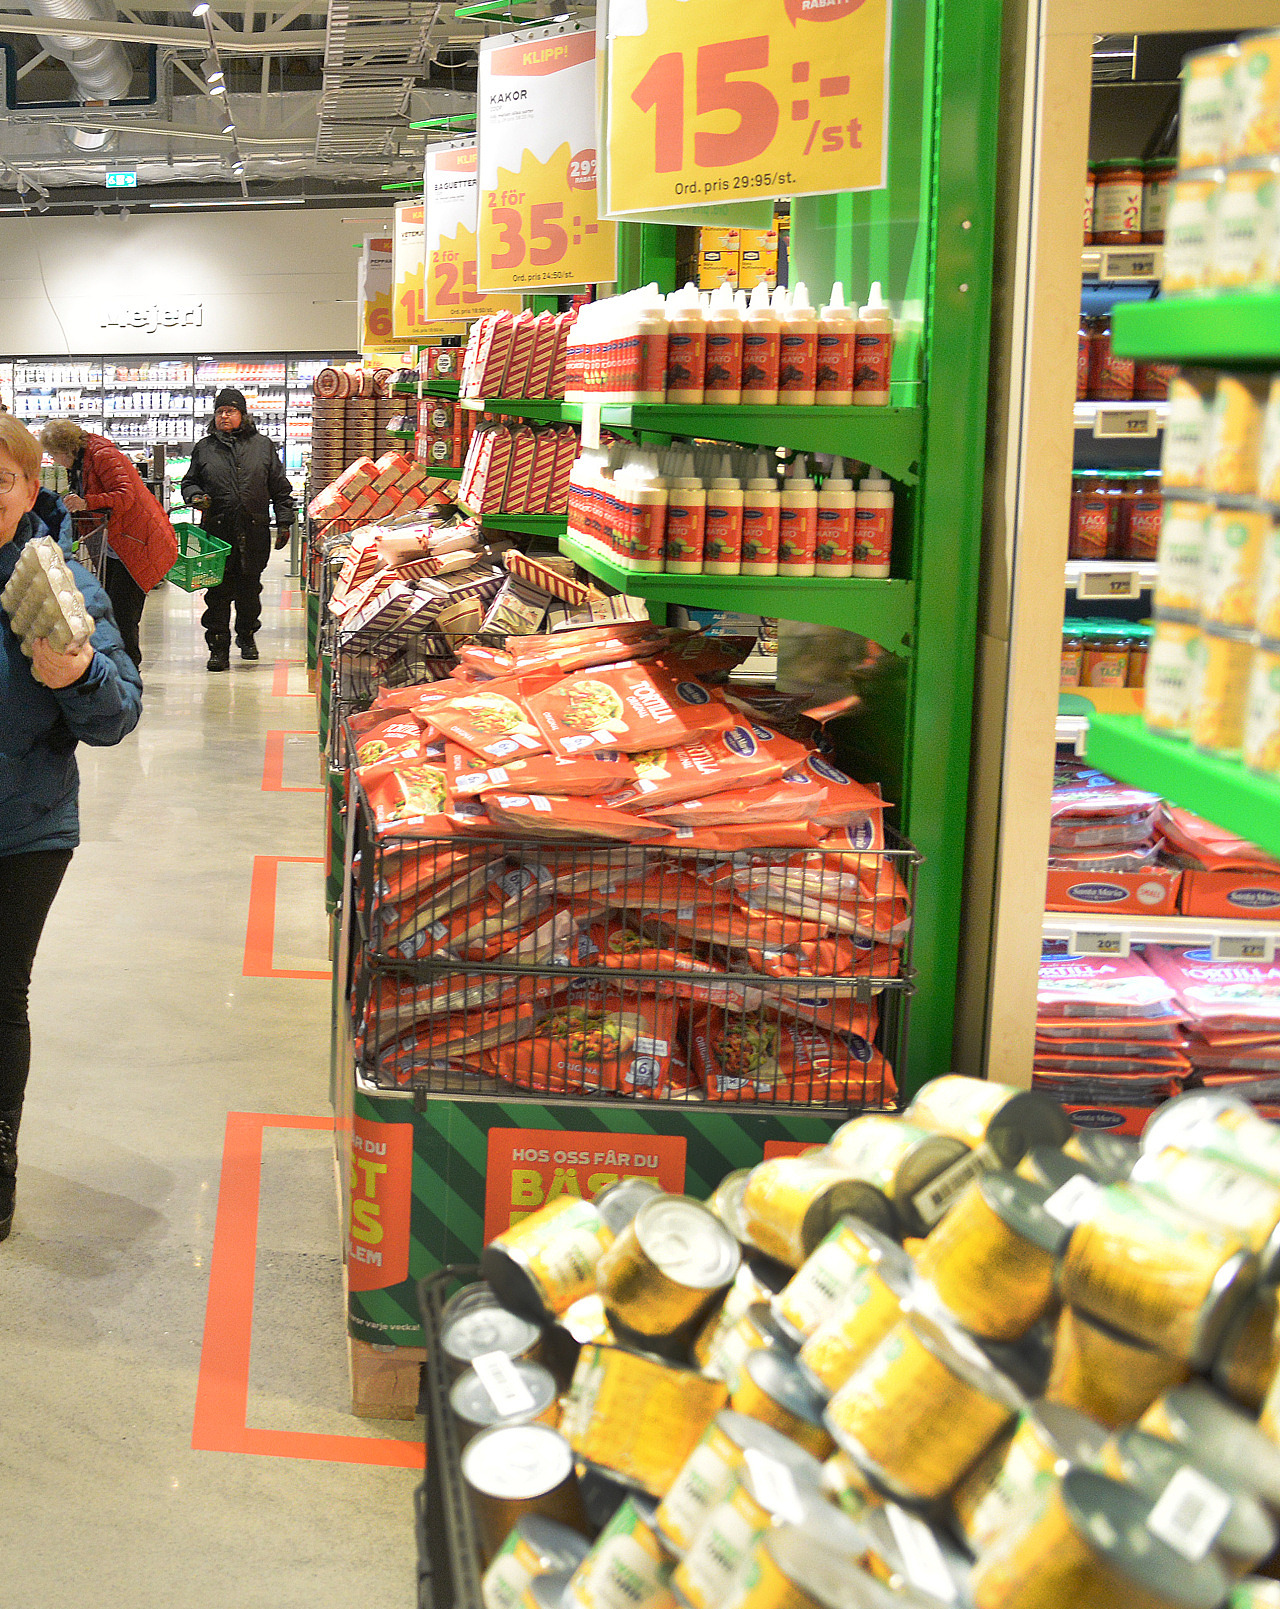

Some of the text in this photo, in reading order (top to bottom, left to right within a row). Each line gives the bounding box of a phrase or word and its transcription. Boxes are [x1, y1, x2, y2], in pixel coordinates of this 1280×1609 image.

[523, 45, 568, 65] KLIPP!
[490, 90, 528, 104] KAKOR
[803, 118, 862, 156] /st
[457, 153, 477, 165] KLIP
[675, 172, 796, 195] Ord. pris 29:95/st.
[488, 190, 526, 208] 2 för
[433, 251, 459, 262] 2 för
[512, 273, 526, 282] Ord.
[528, 272, 541, 282] pris
[1079, 515, 1107, 525] TACO
[1132, 516, 1161, 525] TACO
[629, 680, 677, 724] TORTILLA
[1073, 887, 1124, 897] Santa Maria
[399, 979, 445, 996] ORGINAL
[365, 1141, 387, 1156] DU
[512, 1148, 659, 1168] HOS OSS FÅR DU
[511, 1168, 659, 1206] BÄ
[365, 1319, 388, 1331] varje
